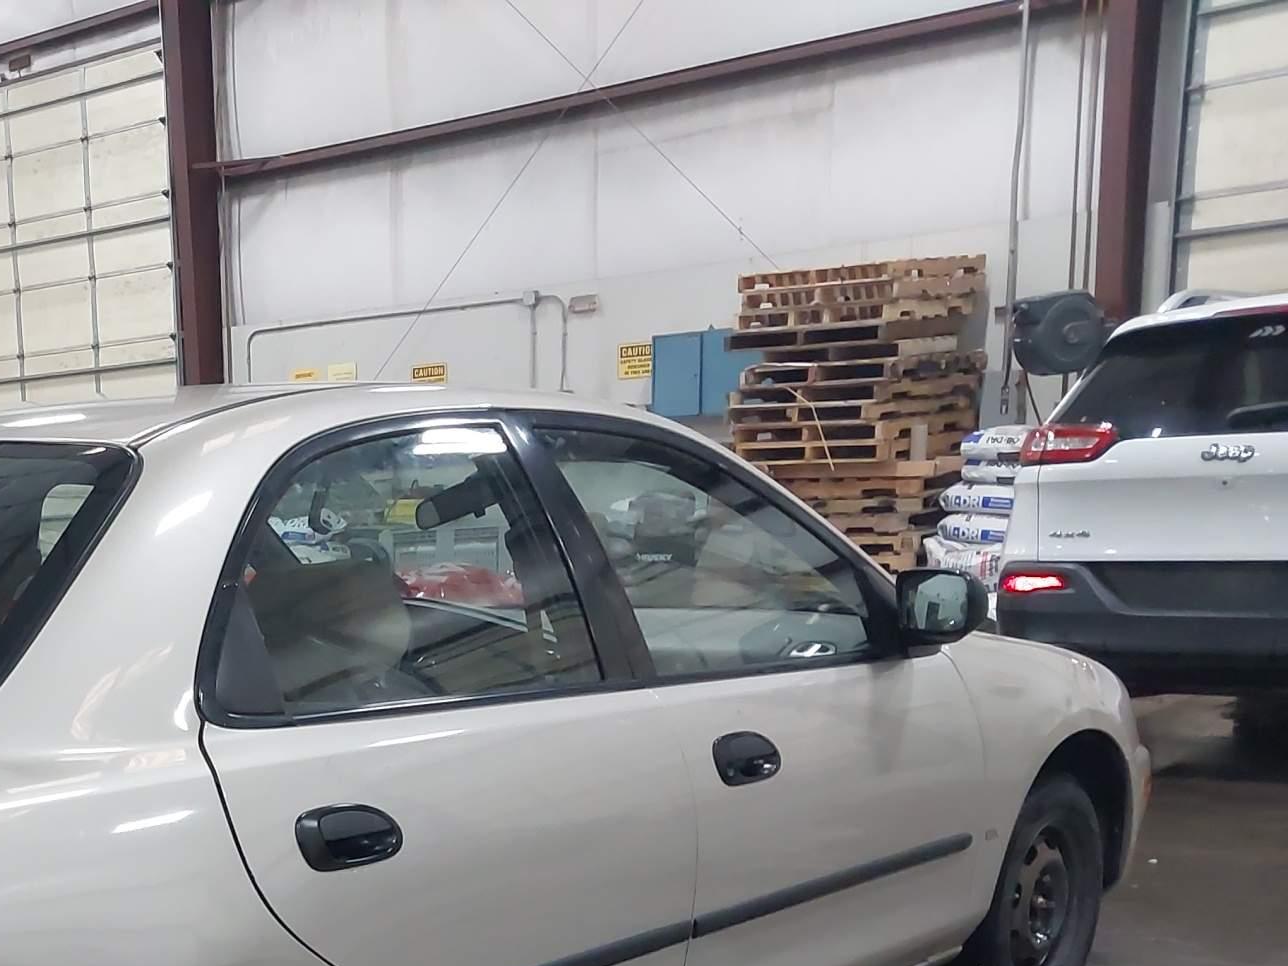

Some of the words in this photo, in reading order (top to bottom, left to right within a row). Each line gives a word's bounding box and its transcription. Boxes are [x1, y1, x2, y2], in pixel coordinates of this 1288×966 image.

[621, 345, 652, 357] CAUTIO
[414, 367, 444, 377] CAUTION
[1201, 443, 1255, 463] Jeep
